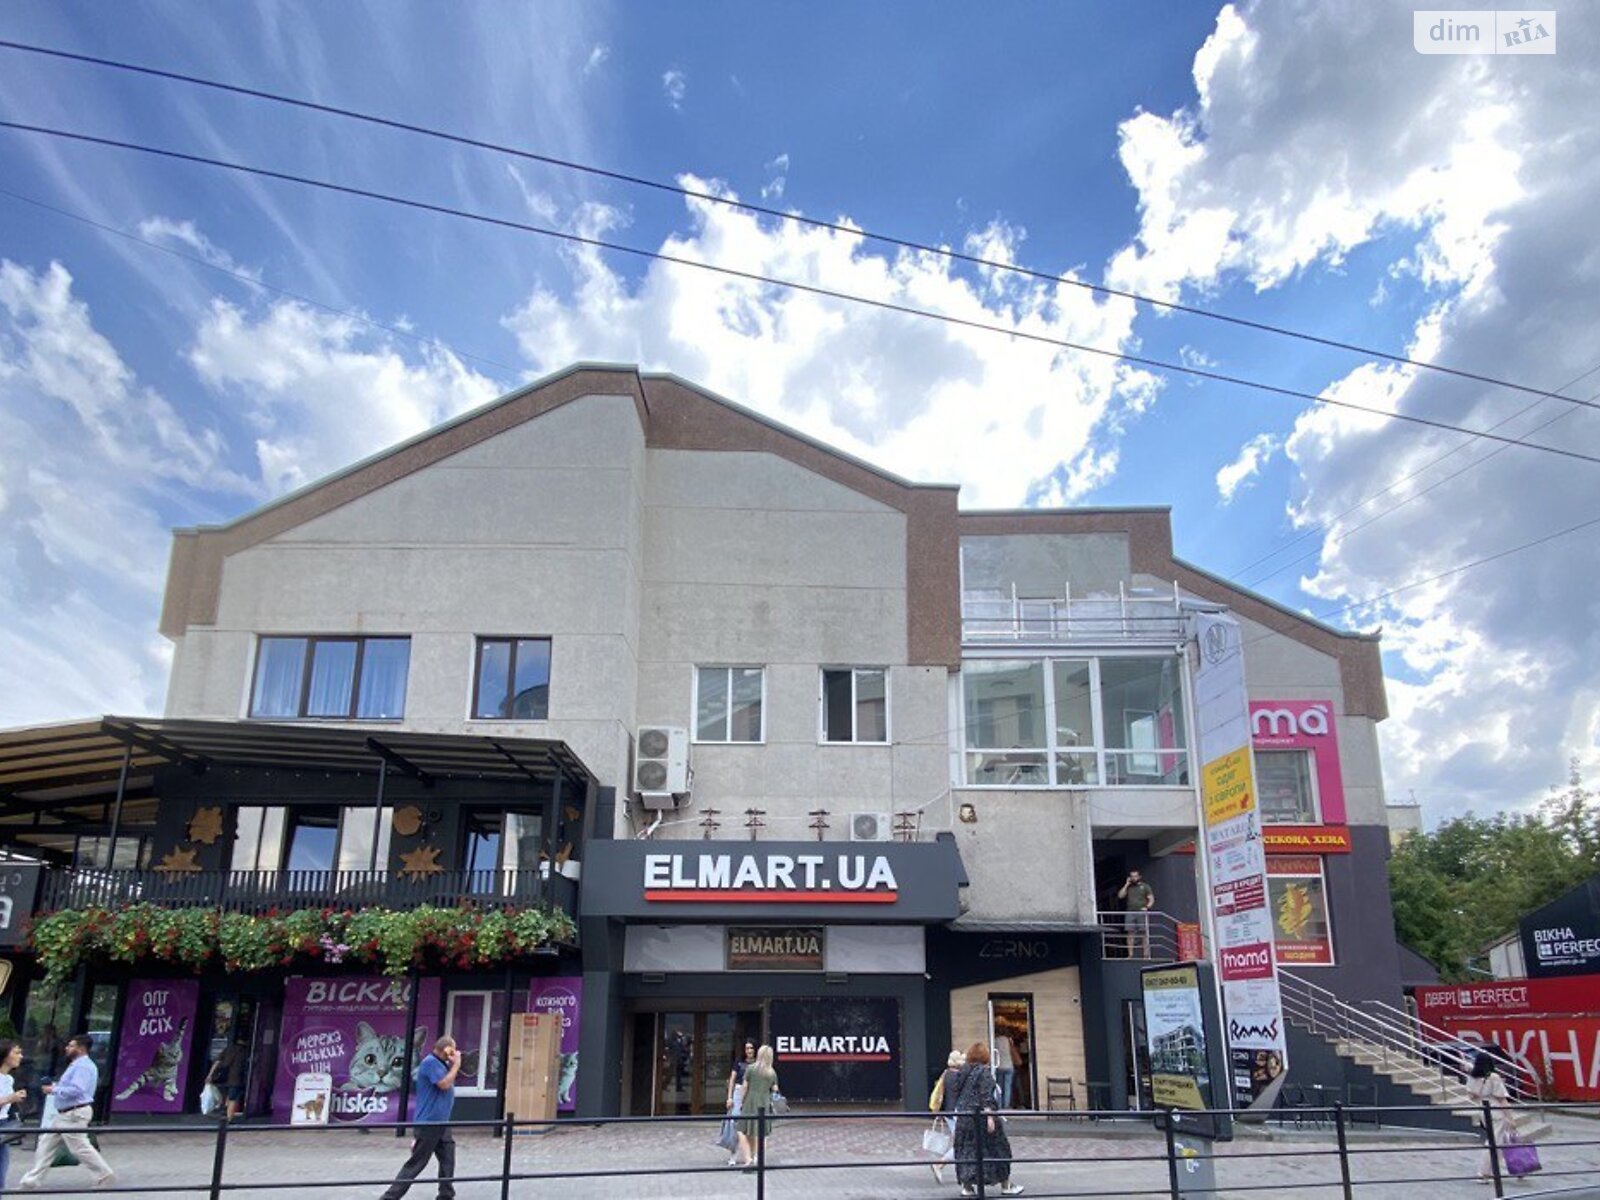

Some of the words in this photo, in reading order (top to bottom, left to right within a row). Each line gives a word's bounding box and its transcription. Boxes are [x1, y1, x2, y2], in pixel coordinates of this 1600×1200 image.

[1313, 835, 1346, 845] ХЕНД
[643, 854, 898, 889] ELMART.UA
[1534, 926, 1575, 942] ВІКНА
[730, 934, 820, 956] ELMART.UA
[143, 990, 169, 1006] ОПТ
[1424, 994, 1457, 1008] ДВЕРІ
[1472, 987, 1527, 1003] PERFECT
[139, 1017, 173, 1035] ВСІХ
[1229, 1018, 1278, 1041] RAMAS
[776, 1035, 891, 1055] ELMART.UA
